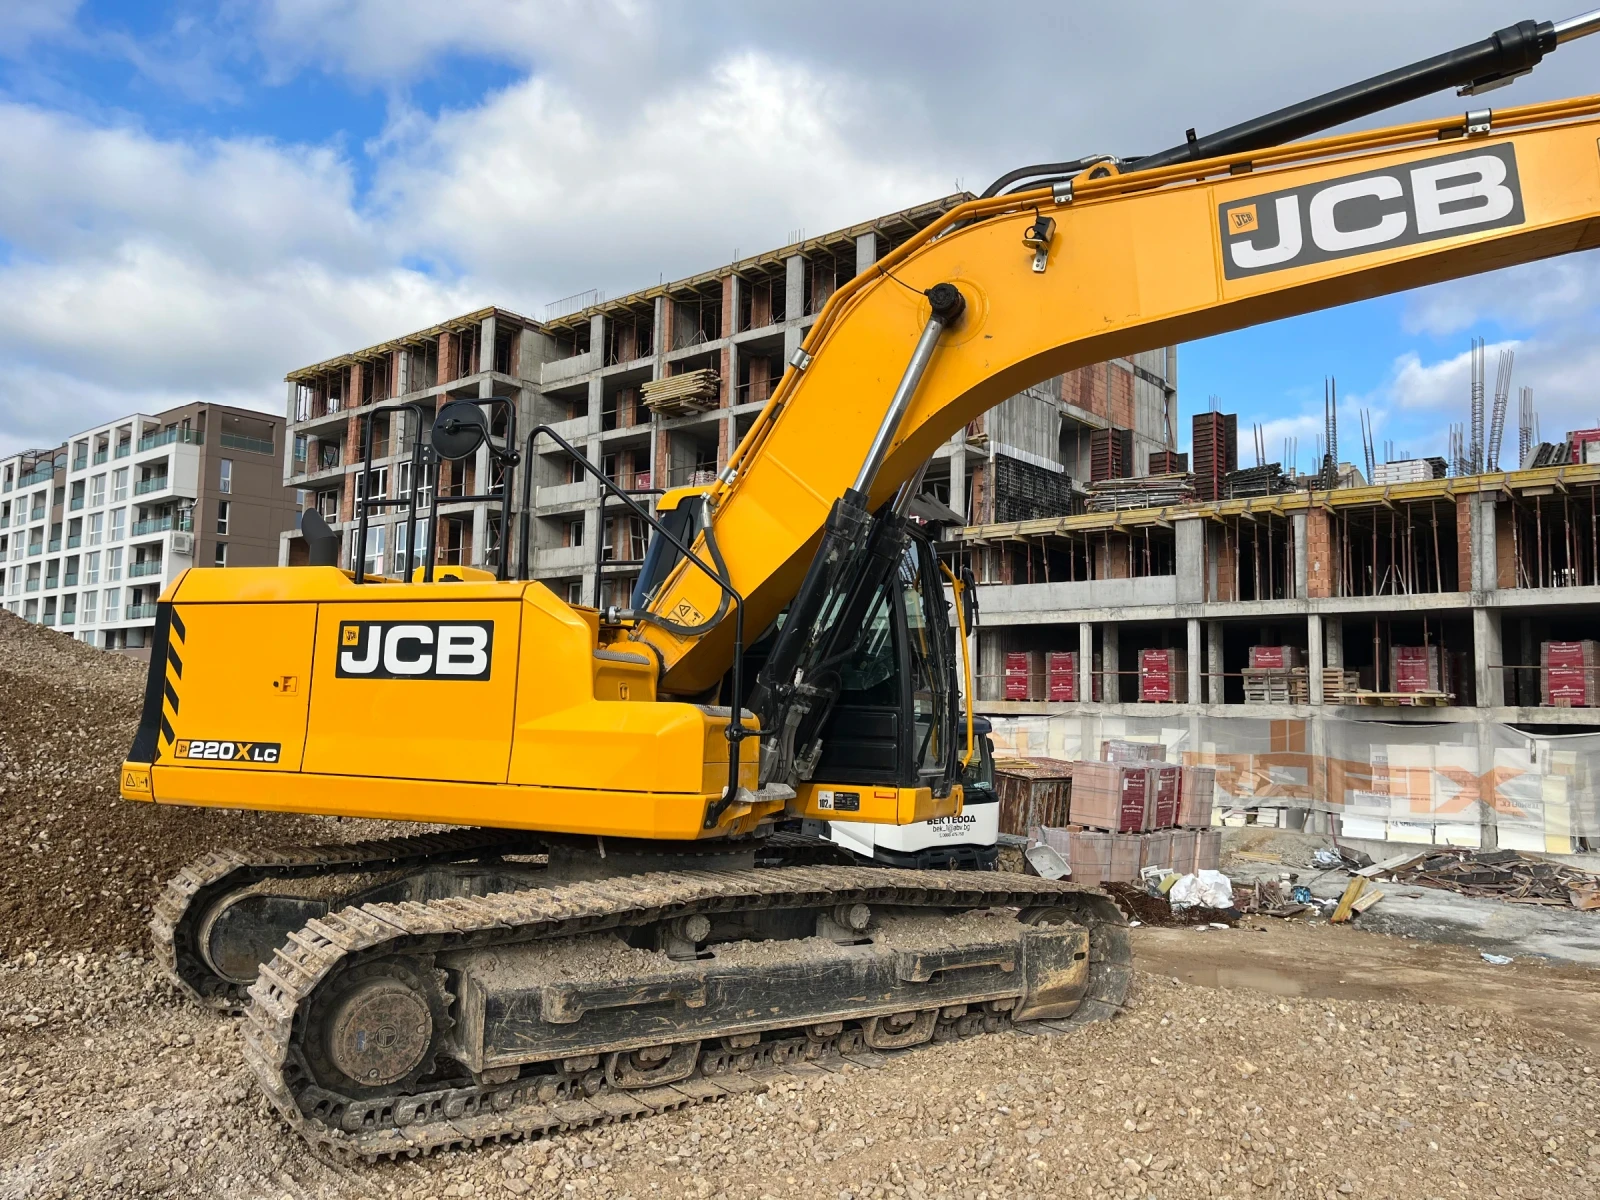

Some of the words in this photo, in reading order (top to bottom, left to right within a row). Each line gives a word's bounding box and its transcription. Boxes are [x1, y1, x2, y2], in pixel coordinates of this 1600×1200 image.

[1230, 155, 1514, 269] JCB
[1234, 213, 1253, 227] JCB
[340, 625, 488, 675] JCB
